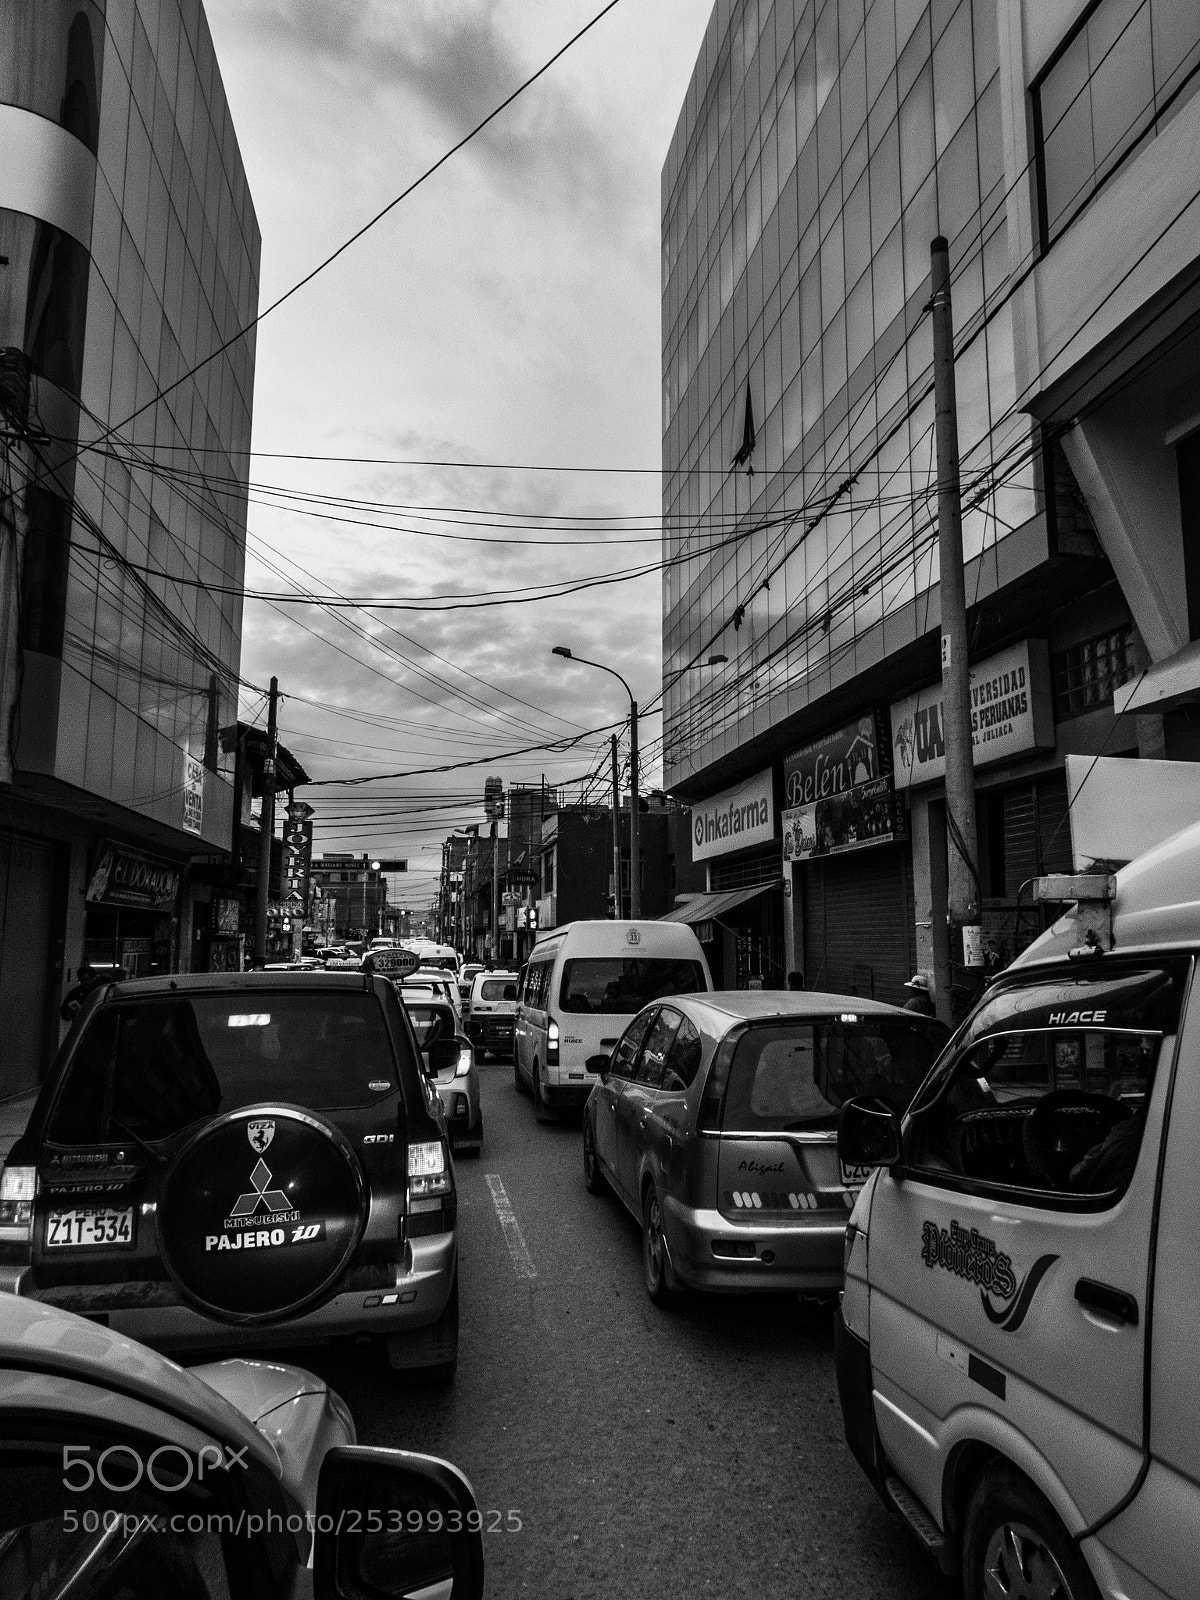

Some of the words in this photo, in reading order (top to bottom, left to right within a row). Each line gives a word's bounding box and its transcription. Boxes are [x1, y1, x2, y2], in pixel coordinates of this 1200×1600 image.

[980, 692, 1028, 729] PERUANAS
[983, 722, 1013, 743] JULIACA
[787, 753, 847, 808] Belén
[704, 797, 769, 844] Inkafarma
[283, 822, 309, 900] JOYERIA
[378, 957, 415, 967] 329000
[1048, 1010, 1107, 1025] HIACE
[363, 1134, 395, 1144] GDI
[62, 1154, 109, 1164] MITSUBISHI
[738, 1160, 785, 1175] Abigail
[50, 1184, 104, 1194] PAJERO
[223, 1210, 300, 1229] MITSUBISHI
[49, 1215, 129, 1245] Z1T-534
[205, 1228, 285, 1251] PAJERO
